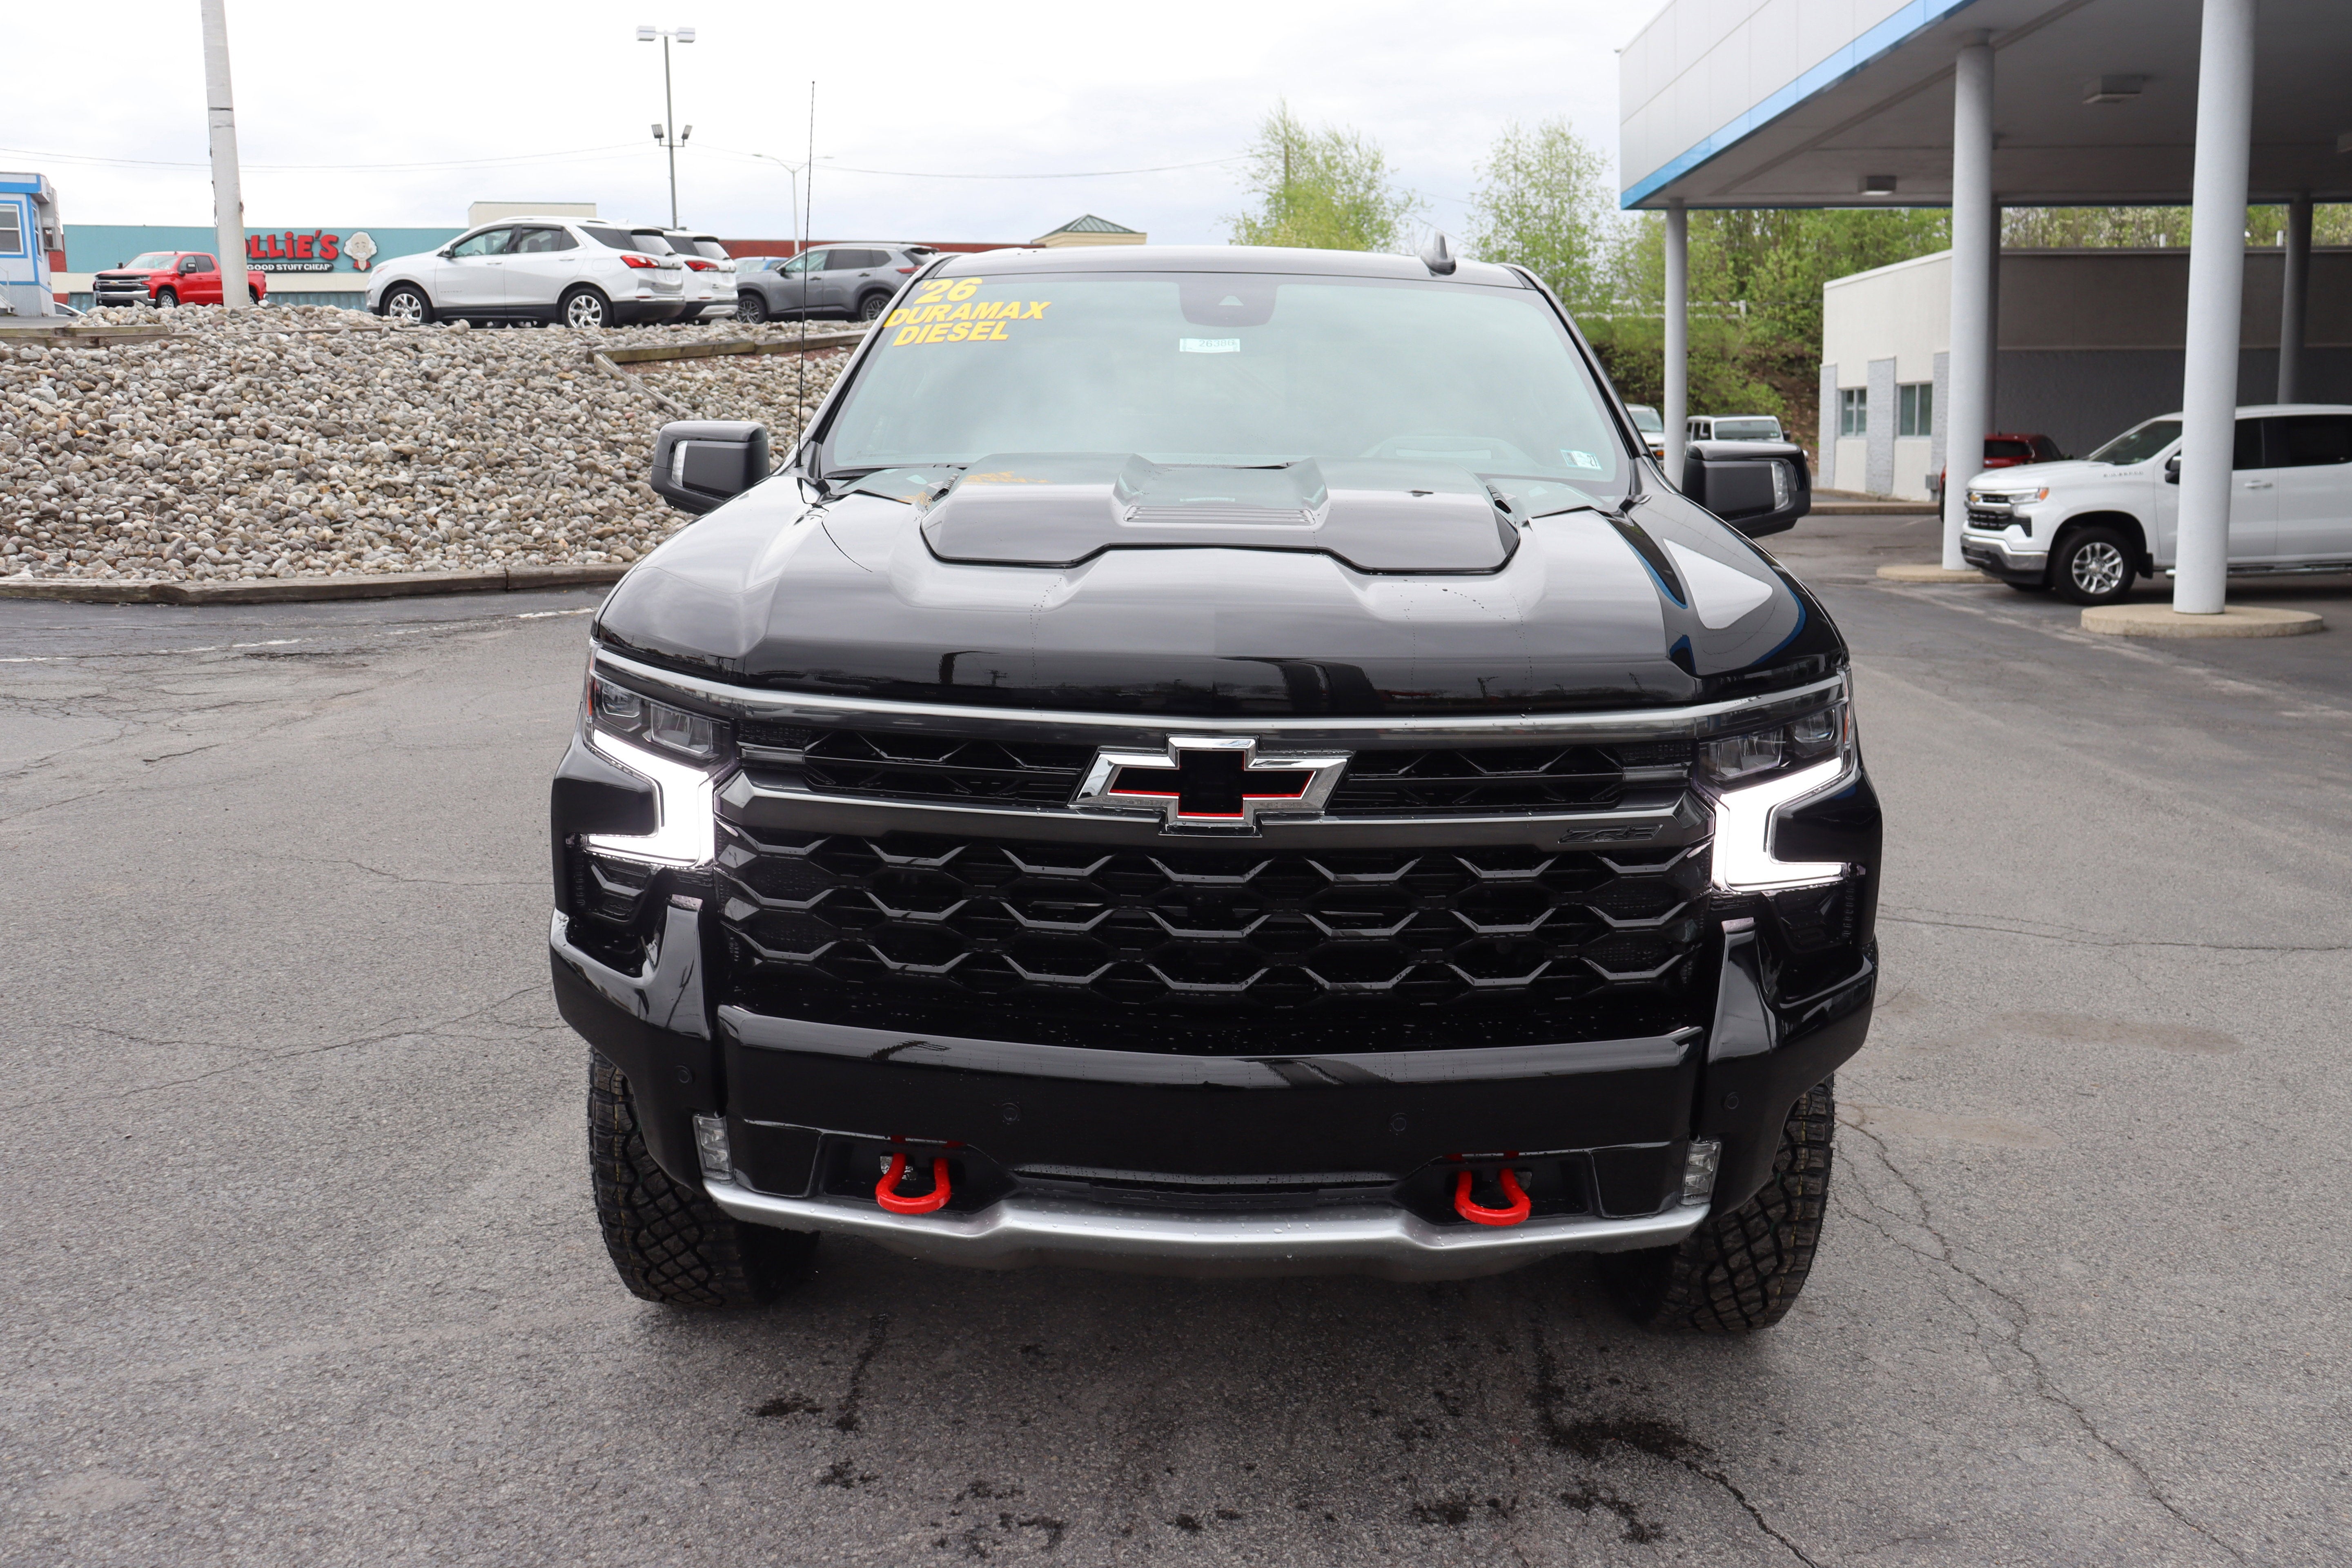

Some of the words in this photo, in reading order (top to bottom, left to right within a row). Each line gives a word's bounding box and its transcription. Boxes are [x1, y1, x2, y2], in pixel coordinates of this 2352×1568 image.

[913, 278, 983, 304] '26
[883, 301, 1051, 327] DURAMAX
[893, 321, 1009, 346] DIESEL
[1199, 339, 1235, 347] 26386
[1558, 824, 1663, 844] ZR2
